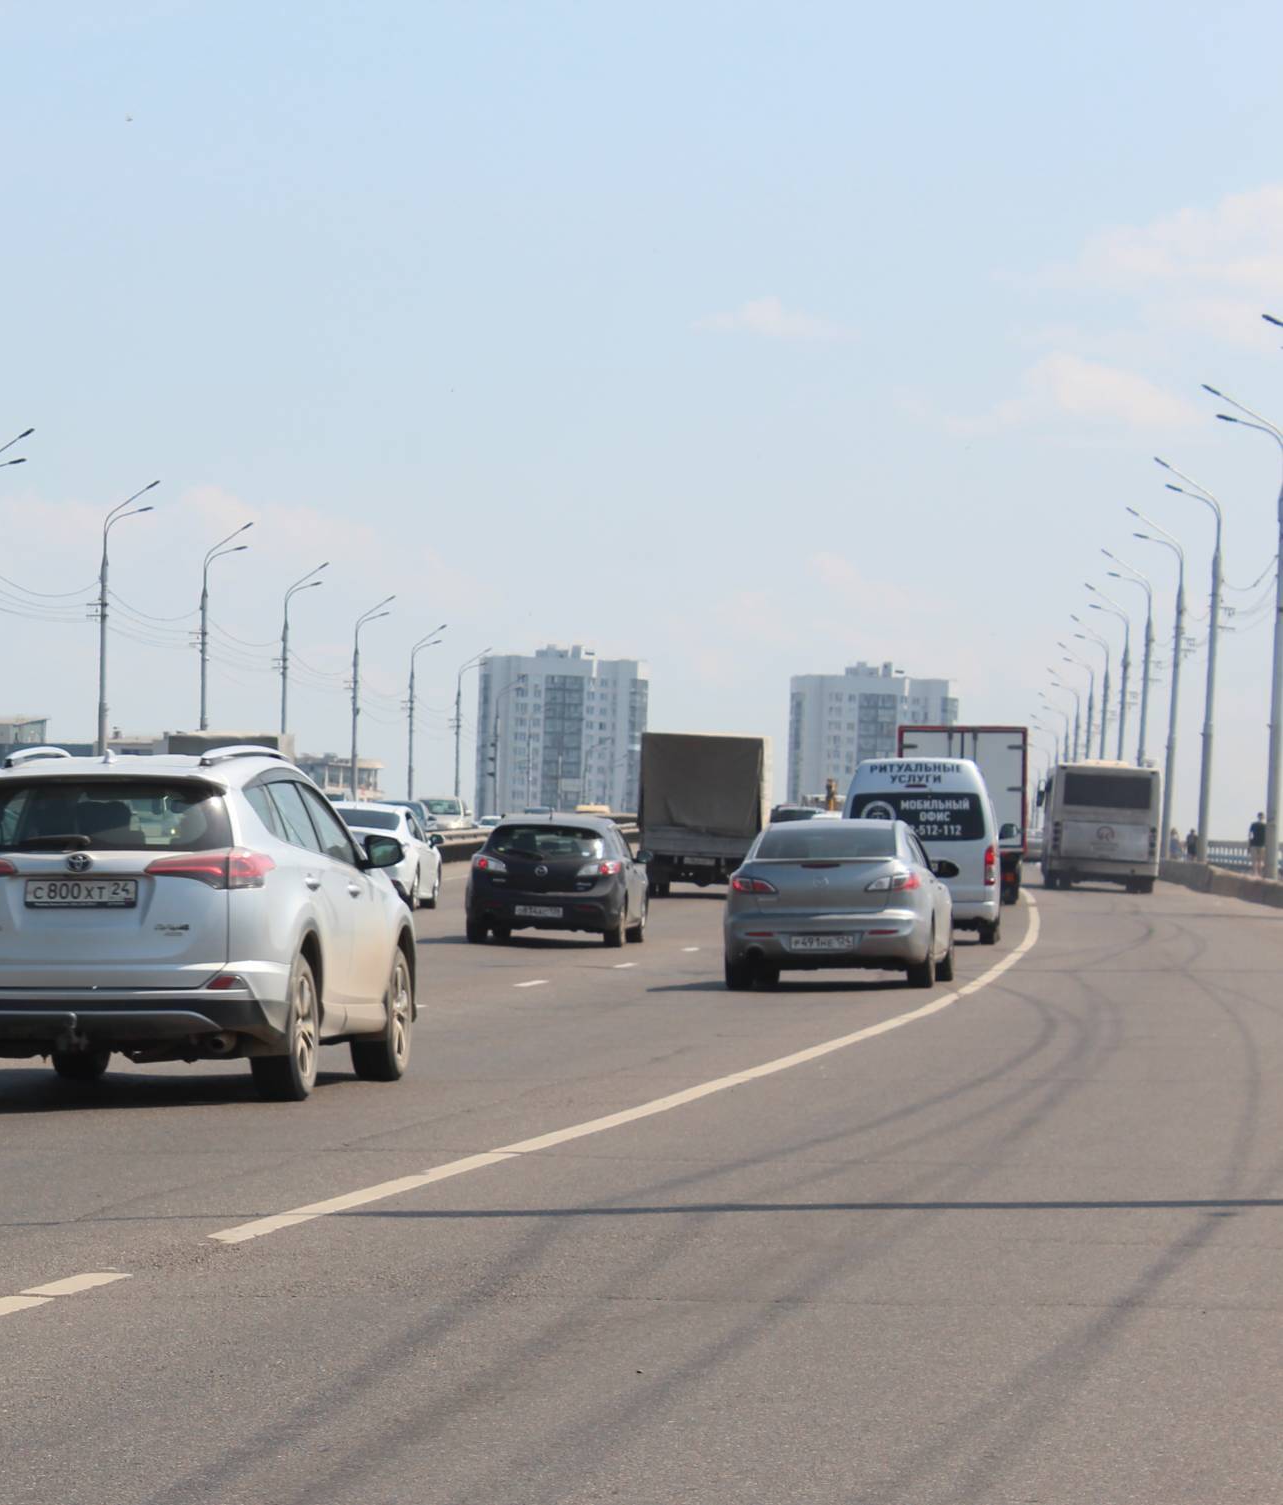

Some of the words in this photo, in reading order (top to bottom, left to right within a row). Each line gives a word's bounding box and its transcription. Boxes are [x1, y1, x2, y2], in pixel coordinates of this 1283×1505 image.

[870, 763, 961, 774] РИТУАЛЬНЫЕ
[890, 774, 941, 784] УСЛУГИ
[900, 798, 970, 810] МОБИЛЬНЫЙ
[919, 811, 951, 822] ОФИС
